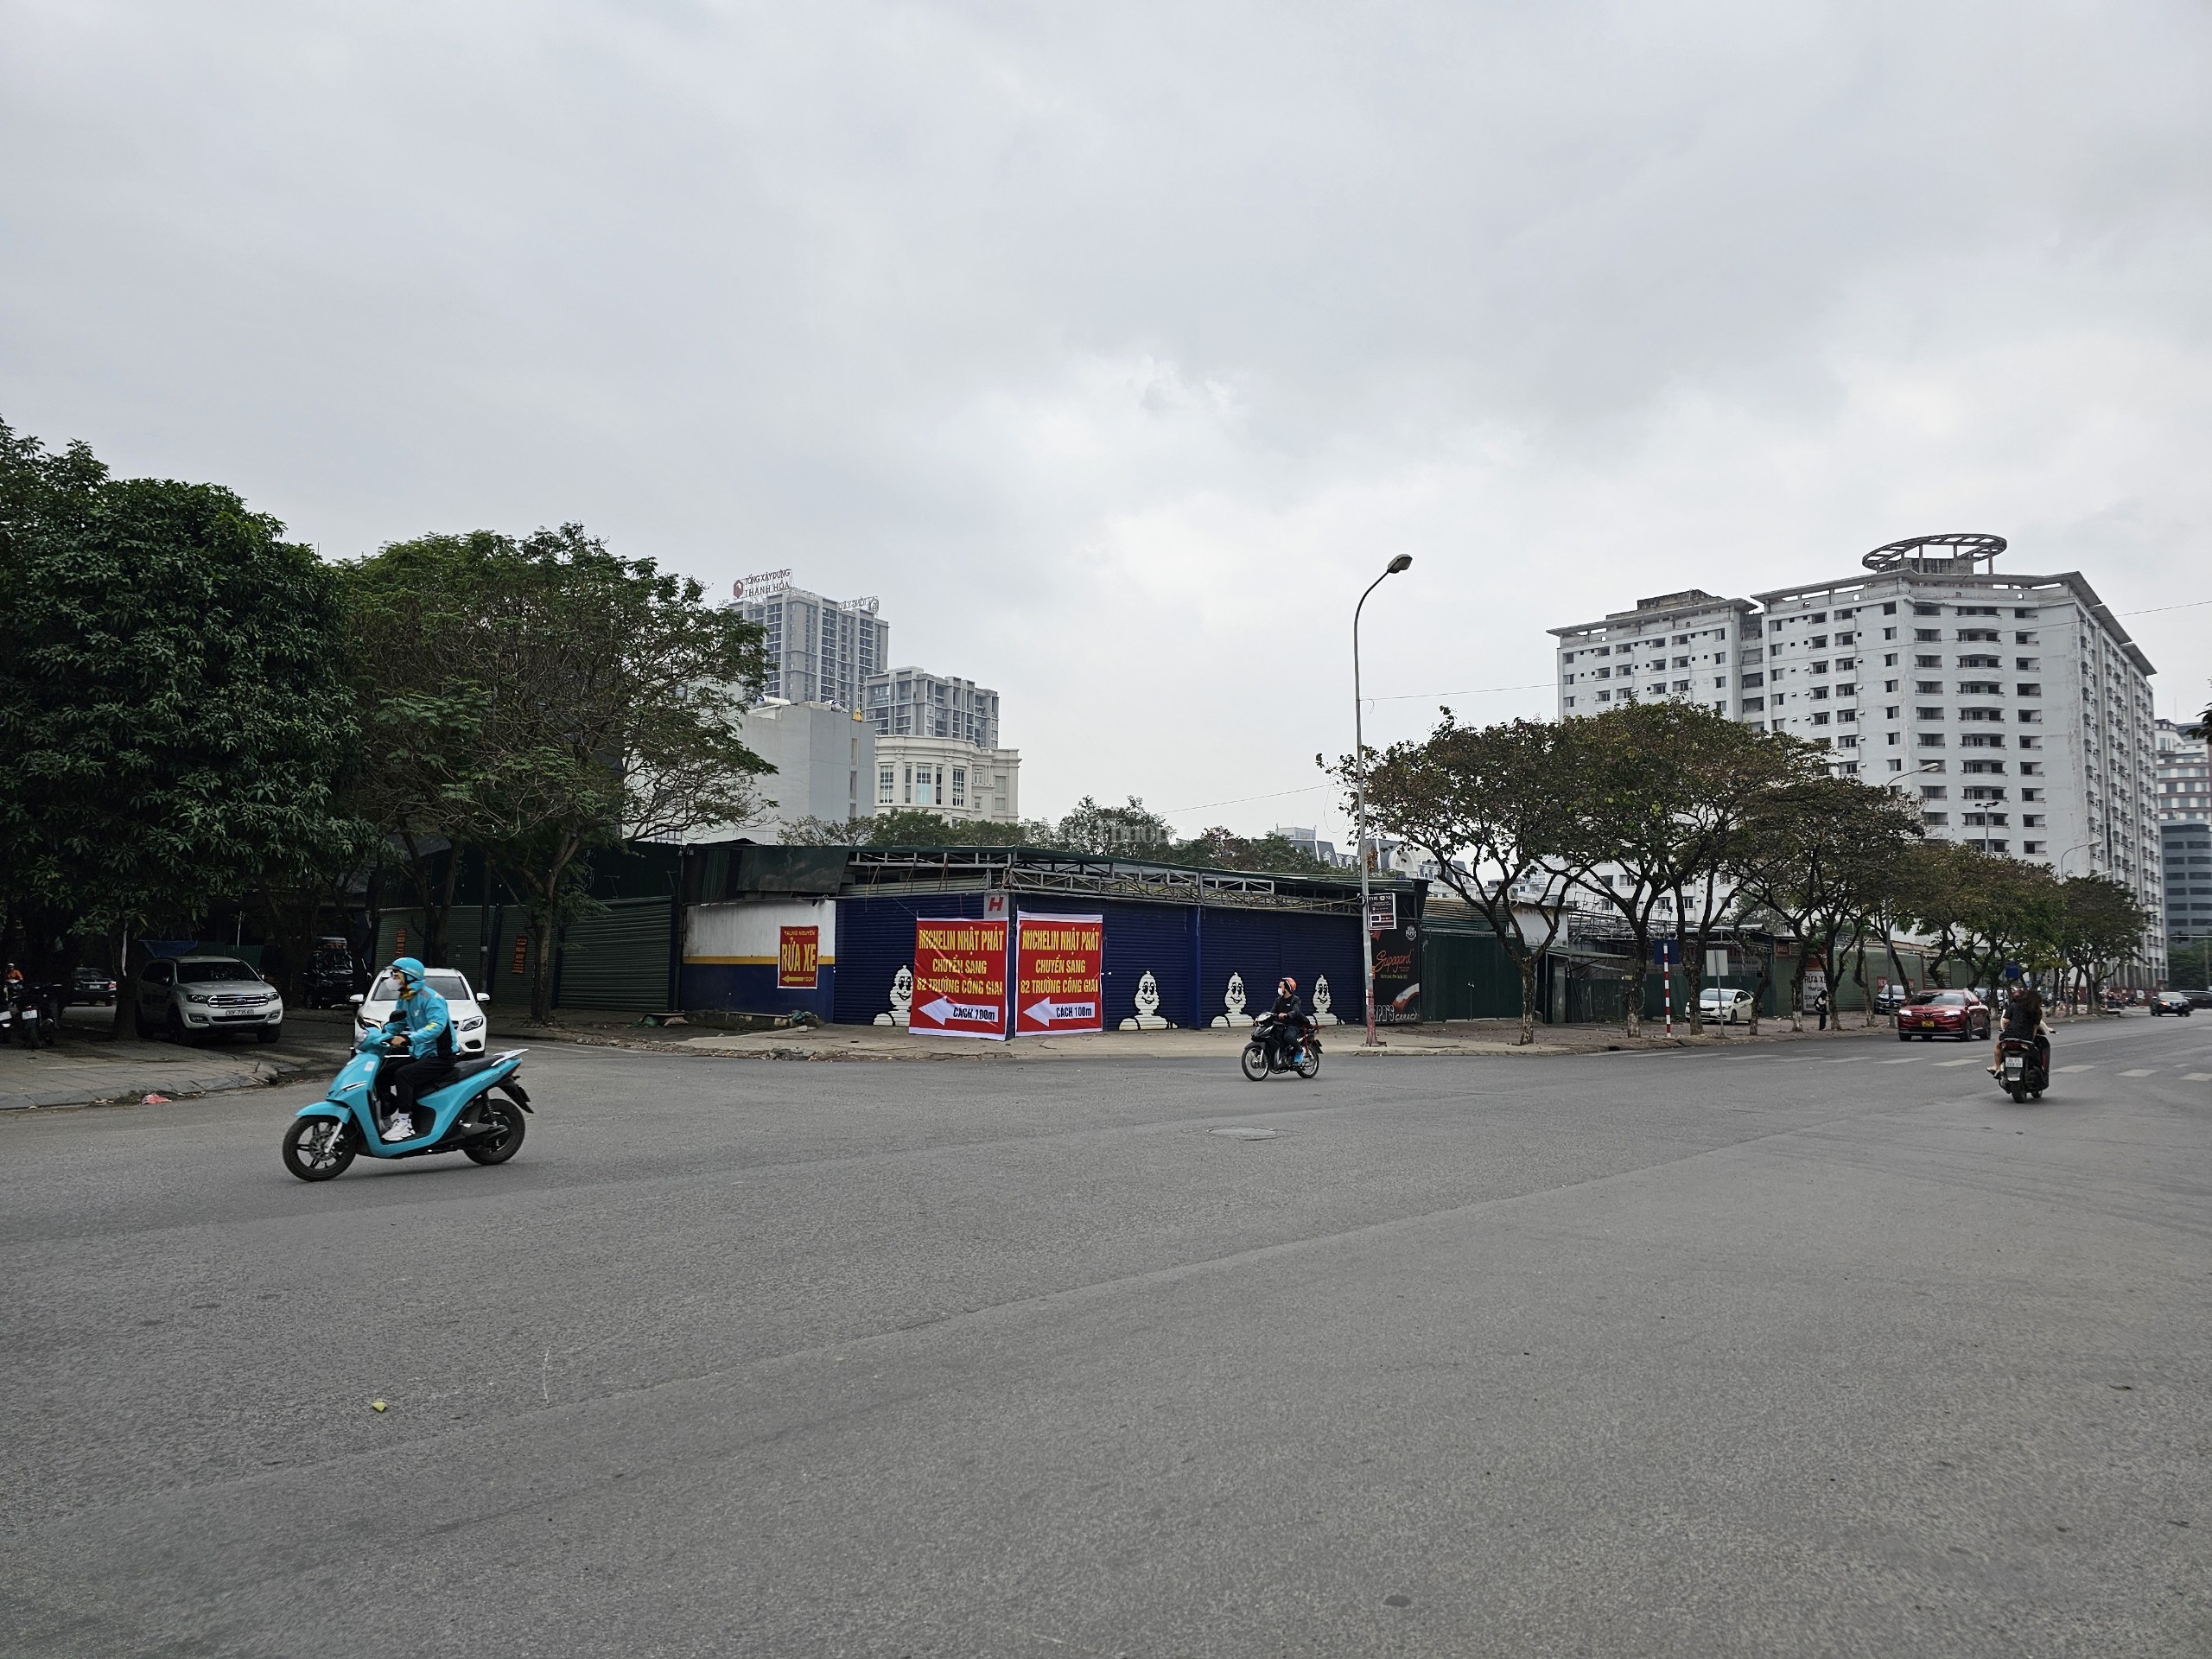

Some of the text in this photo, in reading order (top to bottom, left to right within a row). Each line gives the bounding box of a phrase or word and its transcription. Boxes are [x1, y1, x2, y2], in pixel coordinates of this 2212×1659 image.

[744, 585, 771, 597] THANH
[918, 926, 1004, 955] MICHELIN NHẬT PHÁT
[1022, 927, 1099, 955] MICHELIN NHẬT PHÁT
[781, 937, 817, 972] RỬA XE
[932, 955, 987, 975] CHUYỂN SANG
[1035, 955, 1086, 974] CHUYỂN SANG
[917, 976, 1002, 995] 82 TRƯỜNG CÔNG GIAI
[1020, 976, 1098, 994] 82 TRƯỜNG CÔNG GIAI
[952, 1005, 995, 1020] CÁCH 100m
[1056, 1004, 1092, 1018] CÁCH 100m
